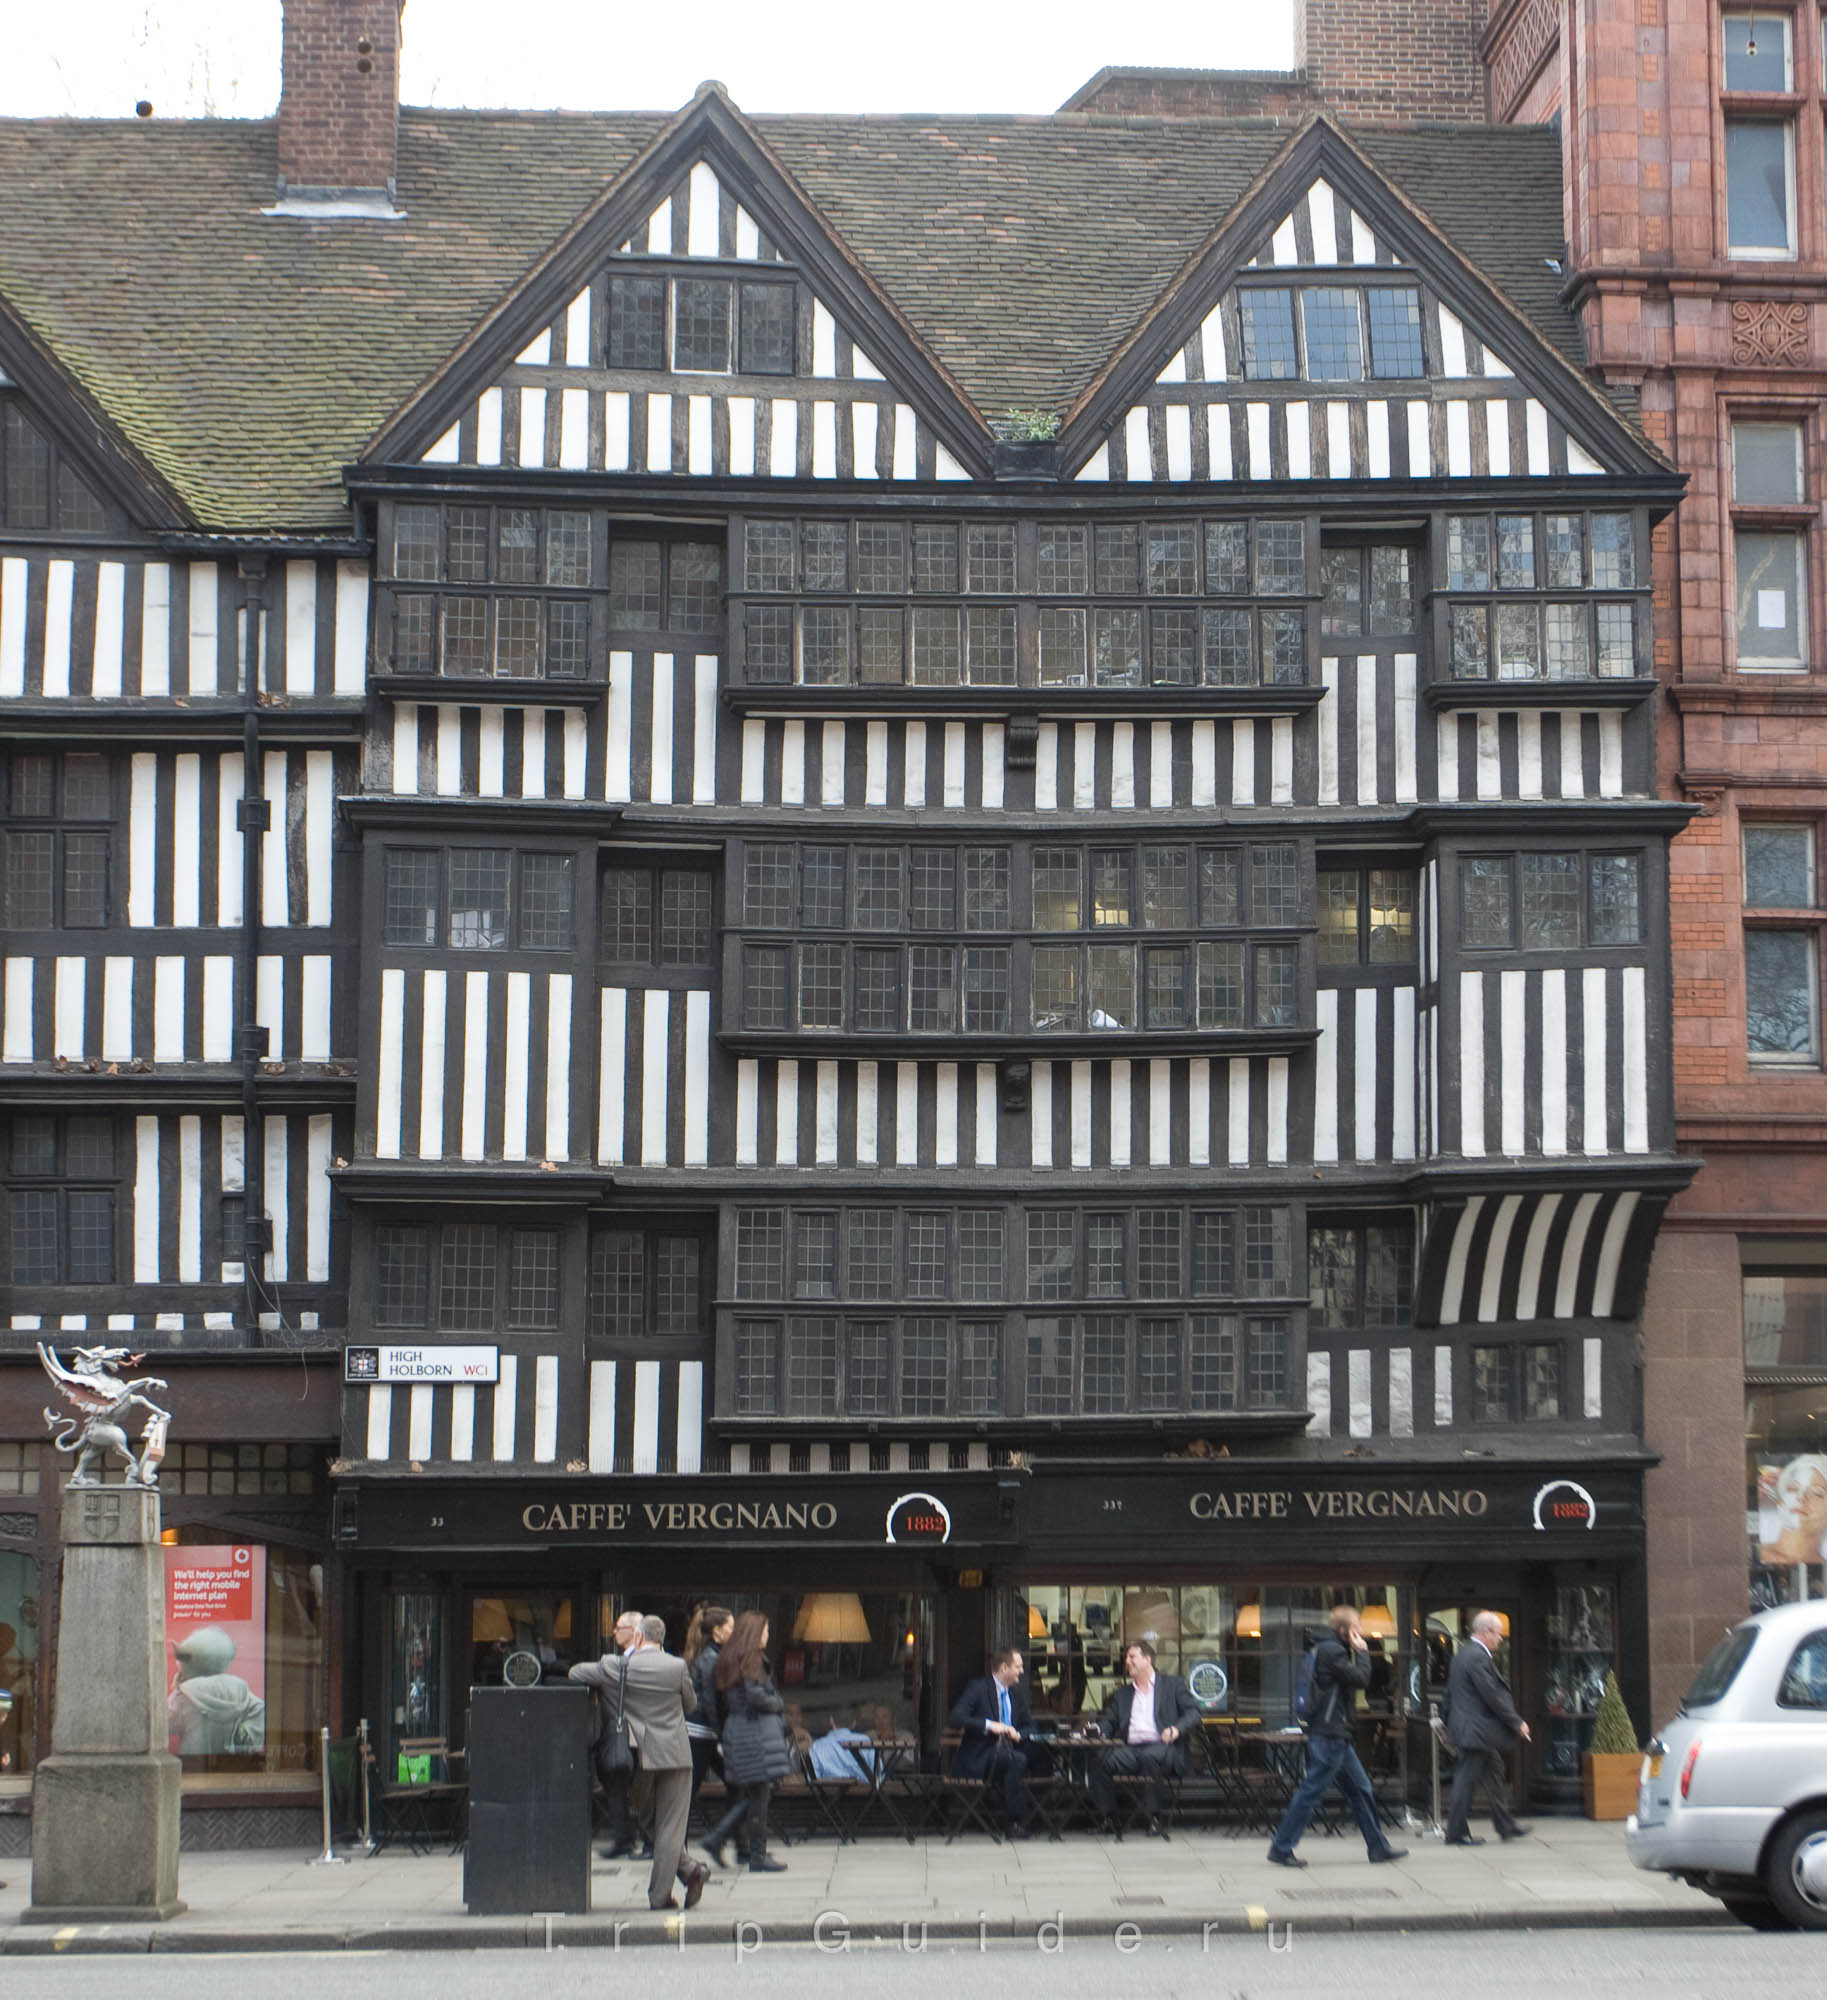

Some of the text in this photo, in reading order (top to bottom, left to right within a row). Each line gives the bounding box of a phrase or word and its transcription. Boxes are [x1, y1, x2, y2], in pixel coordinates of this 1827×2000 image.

[389, 1351, 423, 1362] HIGH
[389, 1364, 453, 1376] HOLBORN
[1189, 1490, 1488, 1518] CAFFE' VERGNANO
[522, 1502, 838, 1530] CAFFE' VERGNANO
[1553, 1503, 1589, 1519] 1882
[907, 1516, 945, 1531] 1882
[174, 1568, 250, 1580] We'll help you find
[174, 1580, 240, 1592] the right mobile
[207, 1591, 228, 1602] plan
